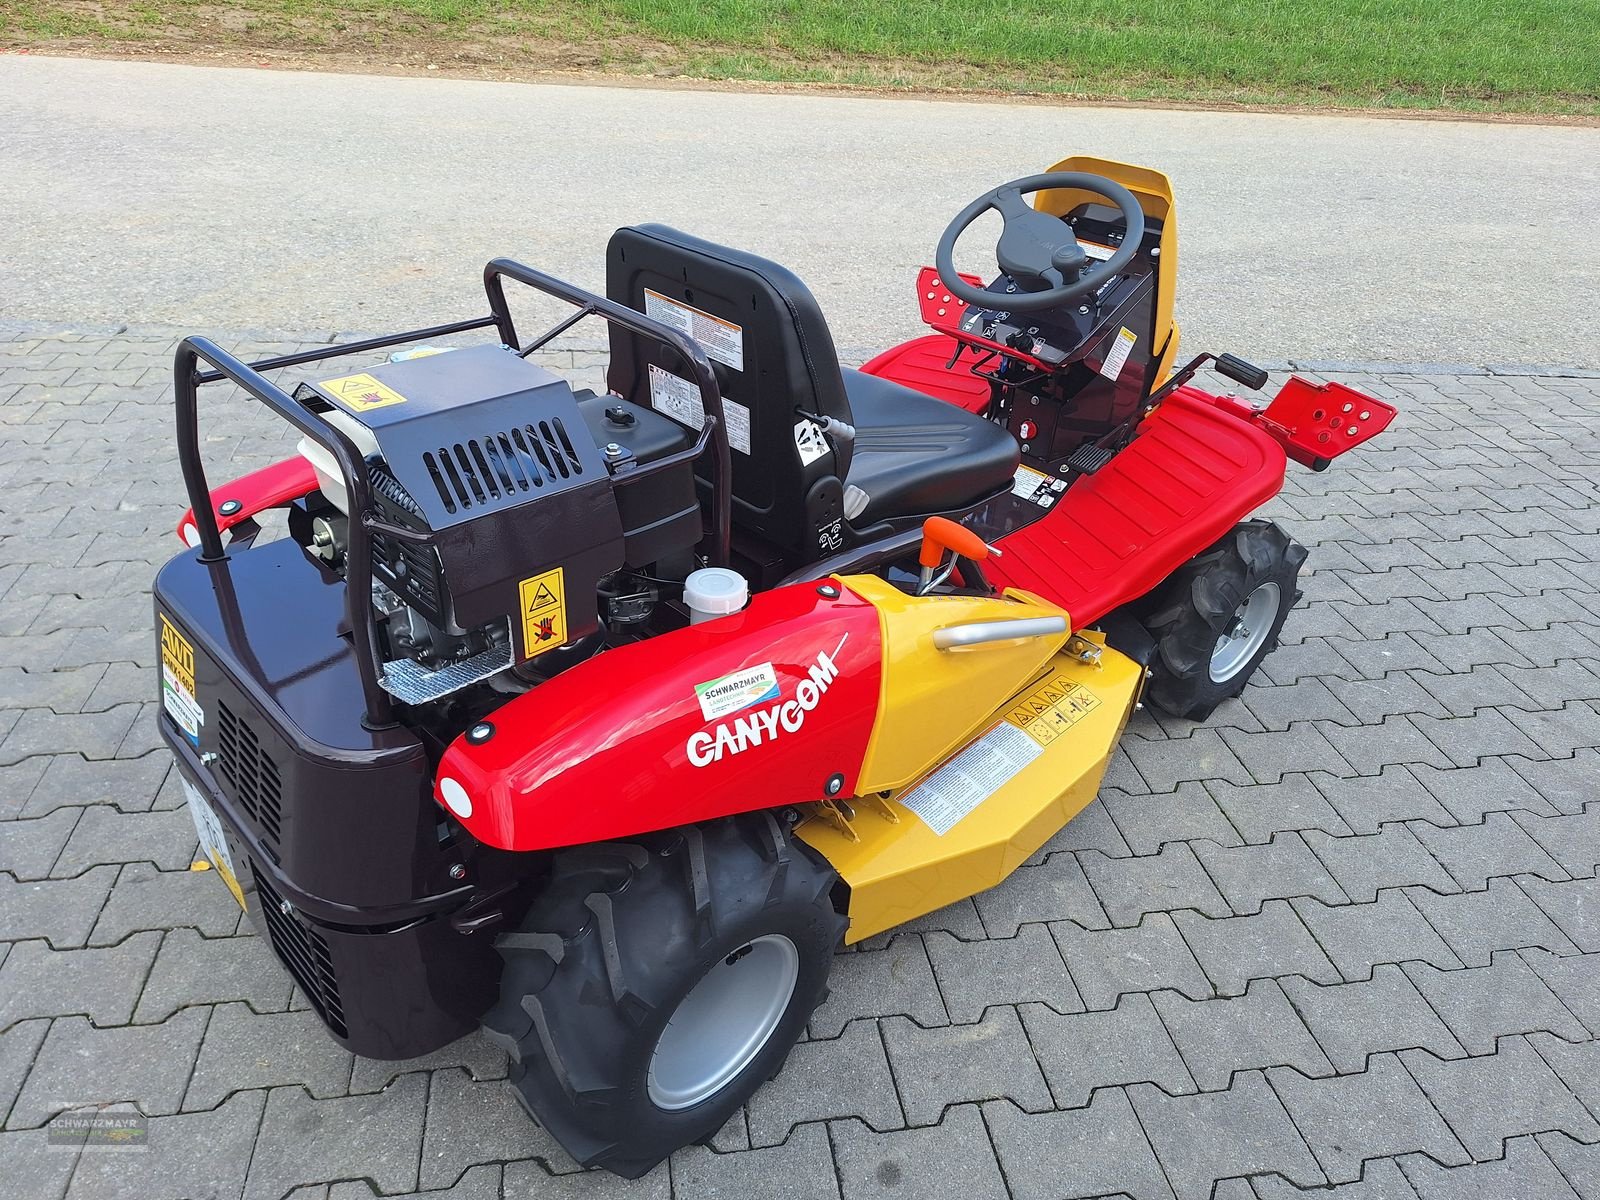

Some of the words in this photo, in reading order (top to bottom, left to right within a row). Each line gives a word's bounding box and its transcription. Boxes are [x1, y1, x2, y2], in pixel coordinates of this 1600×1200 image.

[161, 623, 194, 677] AWD
[686, 632, 849, 768] CANYCOM
[705, 673, 766, 700] SCHWARZMAYR
